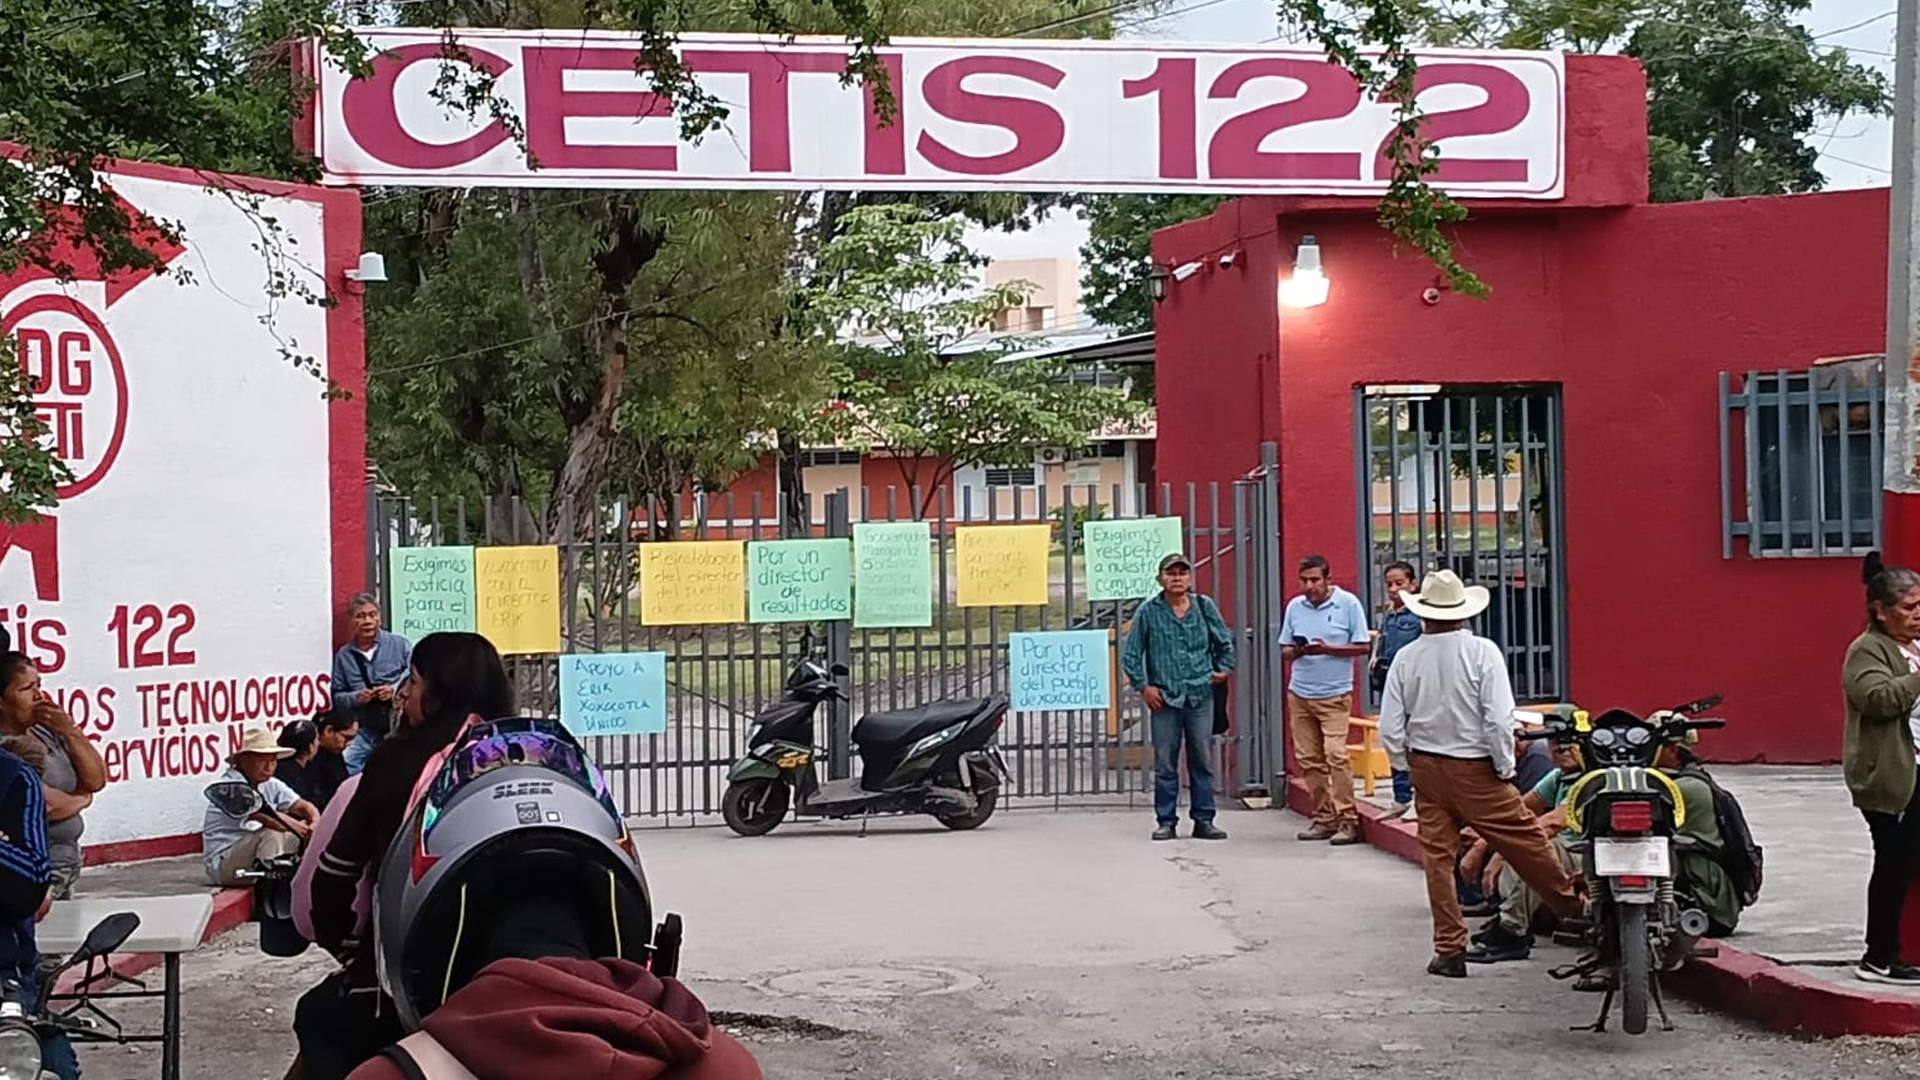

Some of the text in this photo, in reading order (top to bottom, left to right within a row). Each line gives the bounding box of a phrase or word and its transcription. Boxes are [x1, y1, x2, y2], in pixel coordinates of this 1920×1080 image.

[342, 43, 1530, 181] CETIS 122
[1092, 527, 1163, 546] Exigimos
[757, 546, 819, 565] Por un
[1096, 545, 1164, 562] respeto
[403, 555, 467, 576] Exigimos
[1094, 563, 1104, 574] a
[758, 565, 831, 586] director
[403, 577, 467, 595] justicia
[780, 583, 802, 599] de
[405, 597, 467, 615] para el
[760, 593, 848, 614] resultados
[107, 604, 196, 669] 122
[1021, 637, 1084, 659] Por un
[574, 658, 644, 677] APOYO A
[1020, 659, 1087, 676] director
[1020, 675, 1098, 692] del pueblo
[136, 673, 331, 729] TECNOLOGICOS
[87, 728, 220, 783] ervicios
